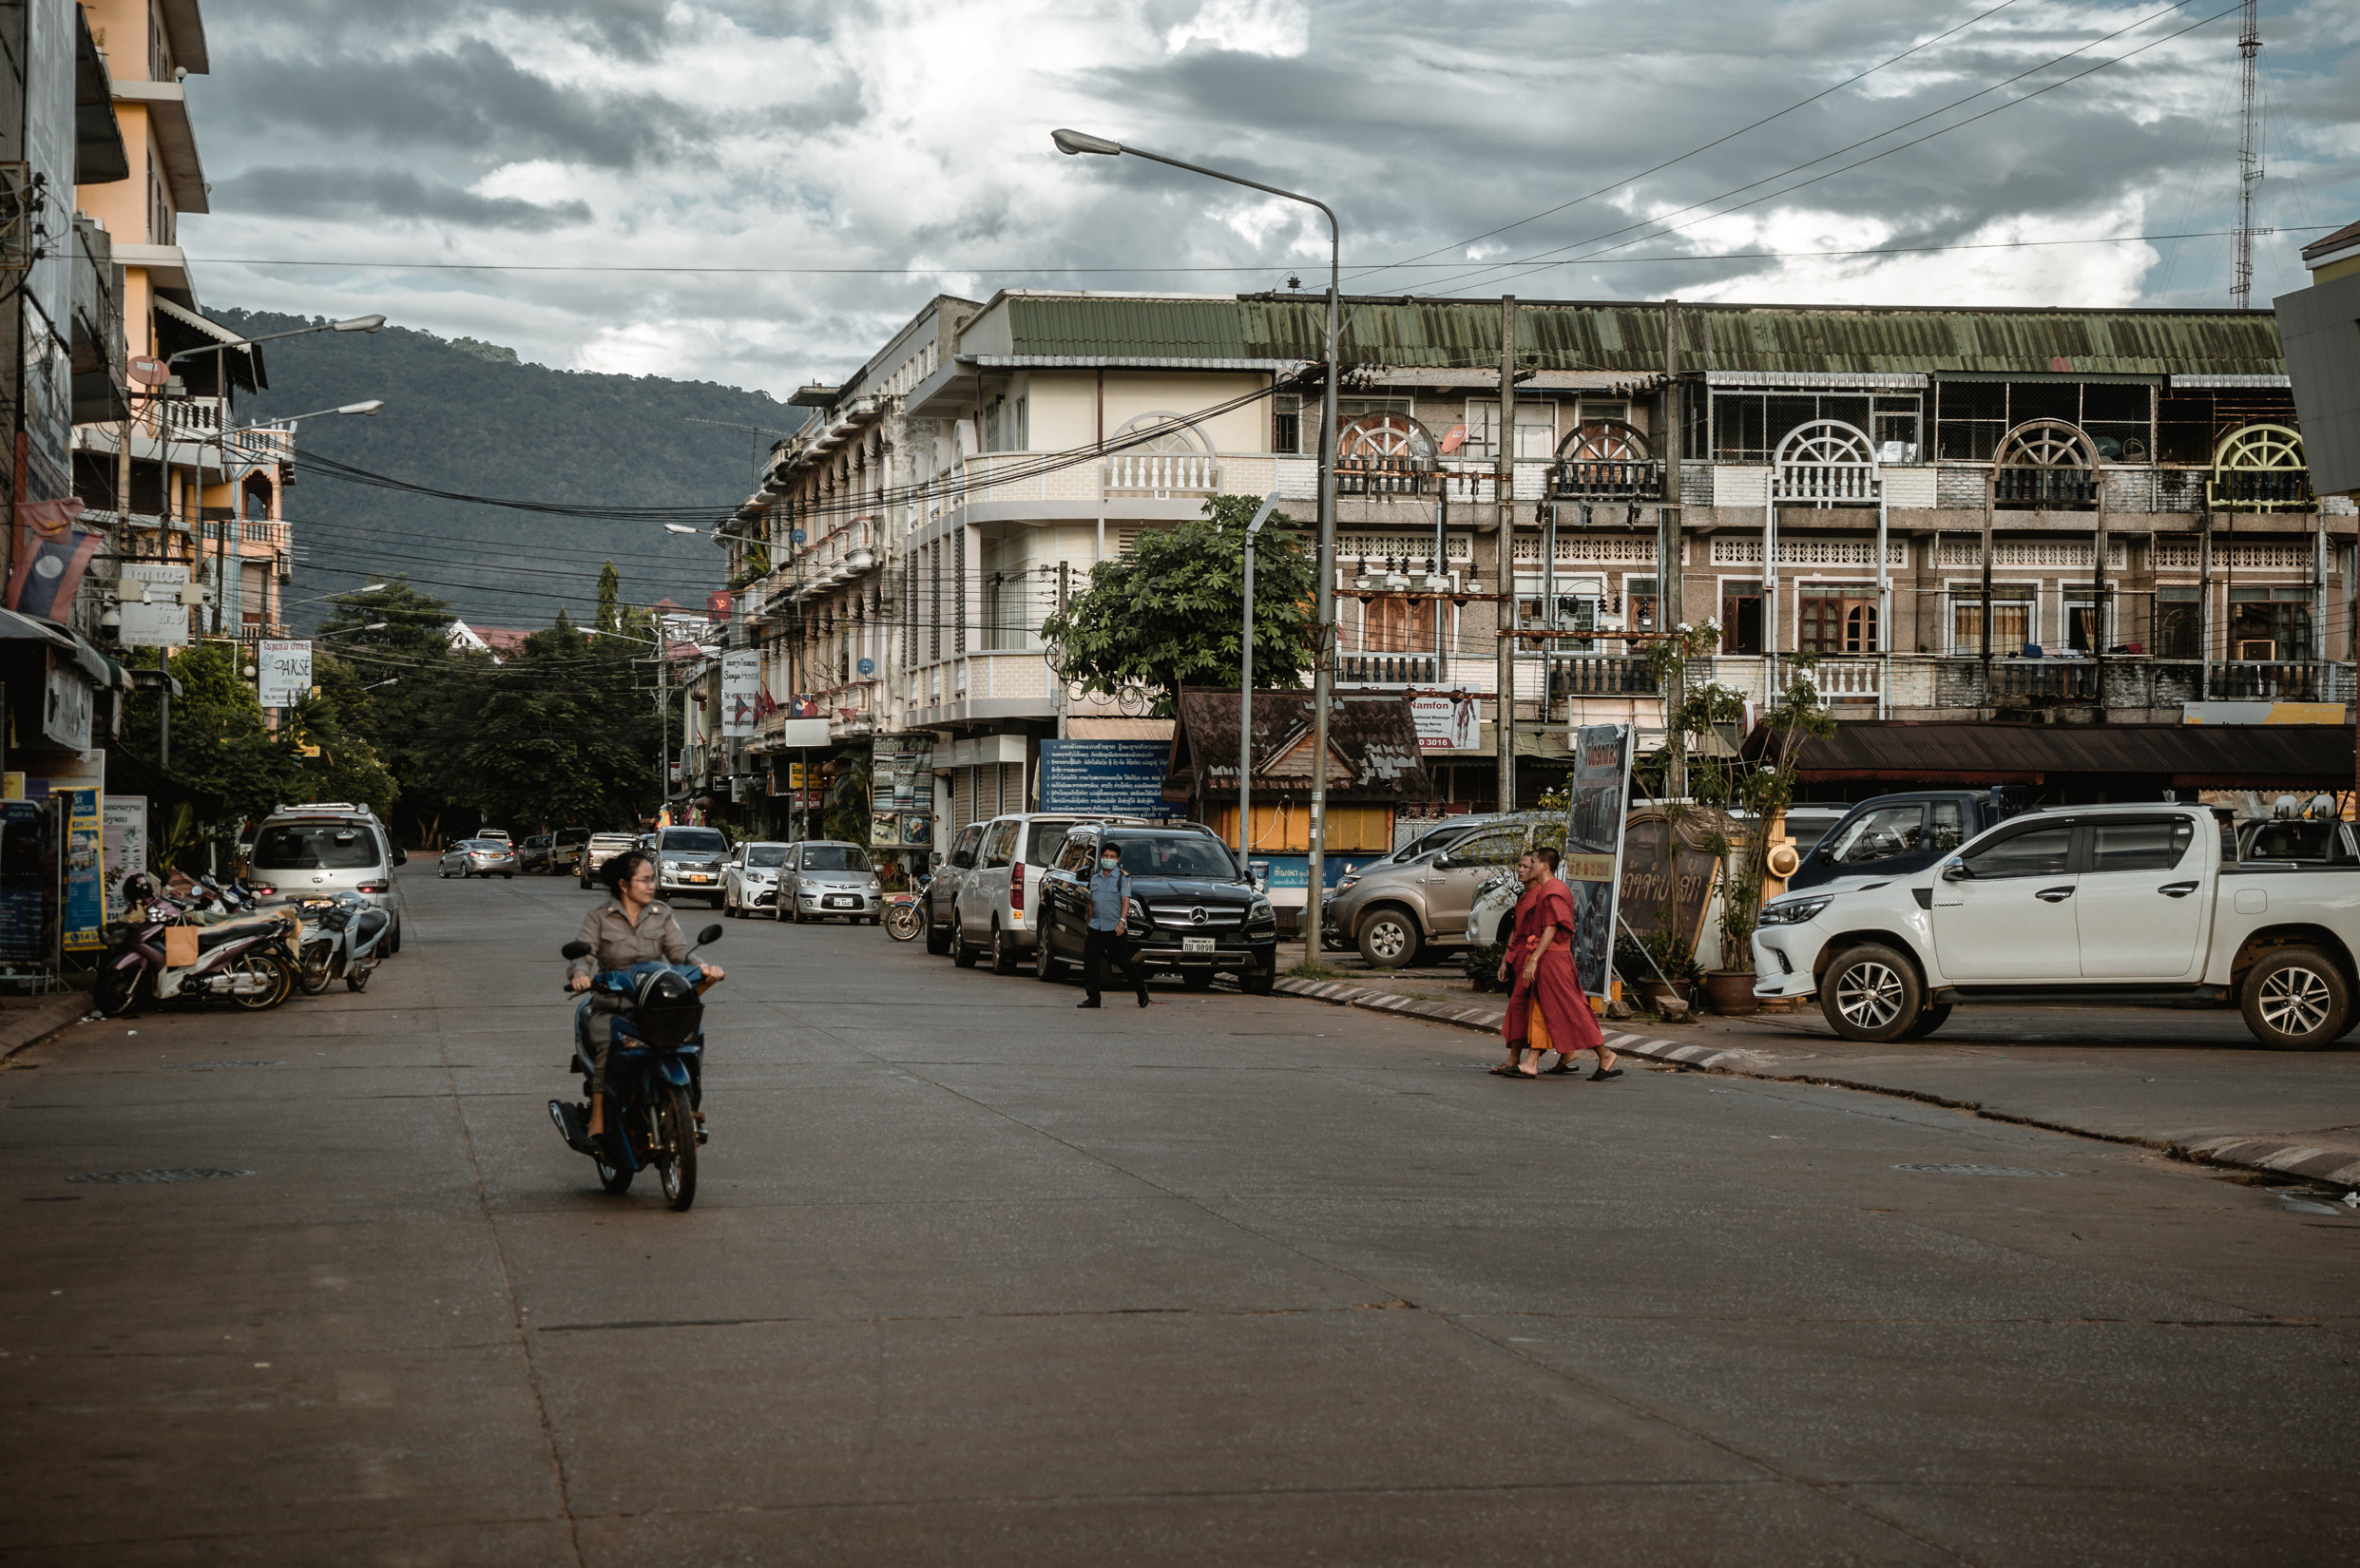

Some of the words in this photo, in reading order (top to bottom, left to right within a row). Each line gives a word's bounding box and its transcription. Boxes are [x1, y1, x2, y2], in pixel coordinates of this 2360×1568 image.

[724, 670, 740, 683] Sanga
[741, 671, 759, 680] Hostel
[1410, 701, 1449, 710] Namfon
[1196, 944, 1213, 952] 9898
